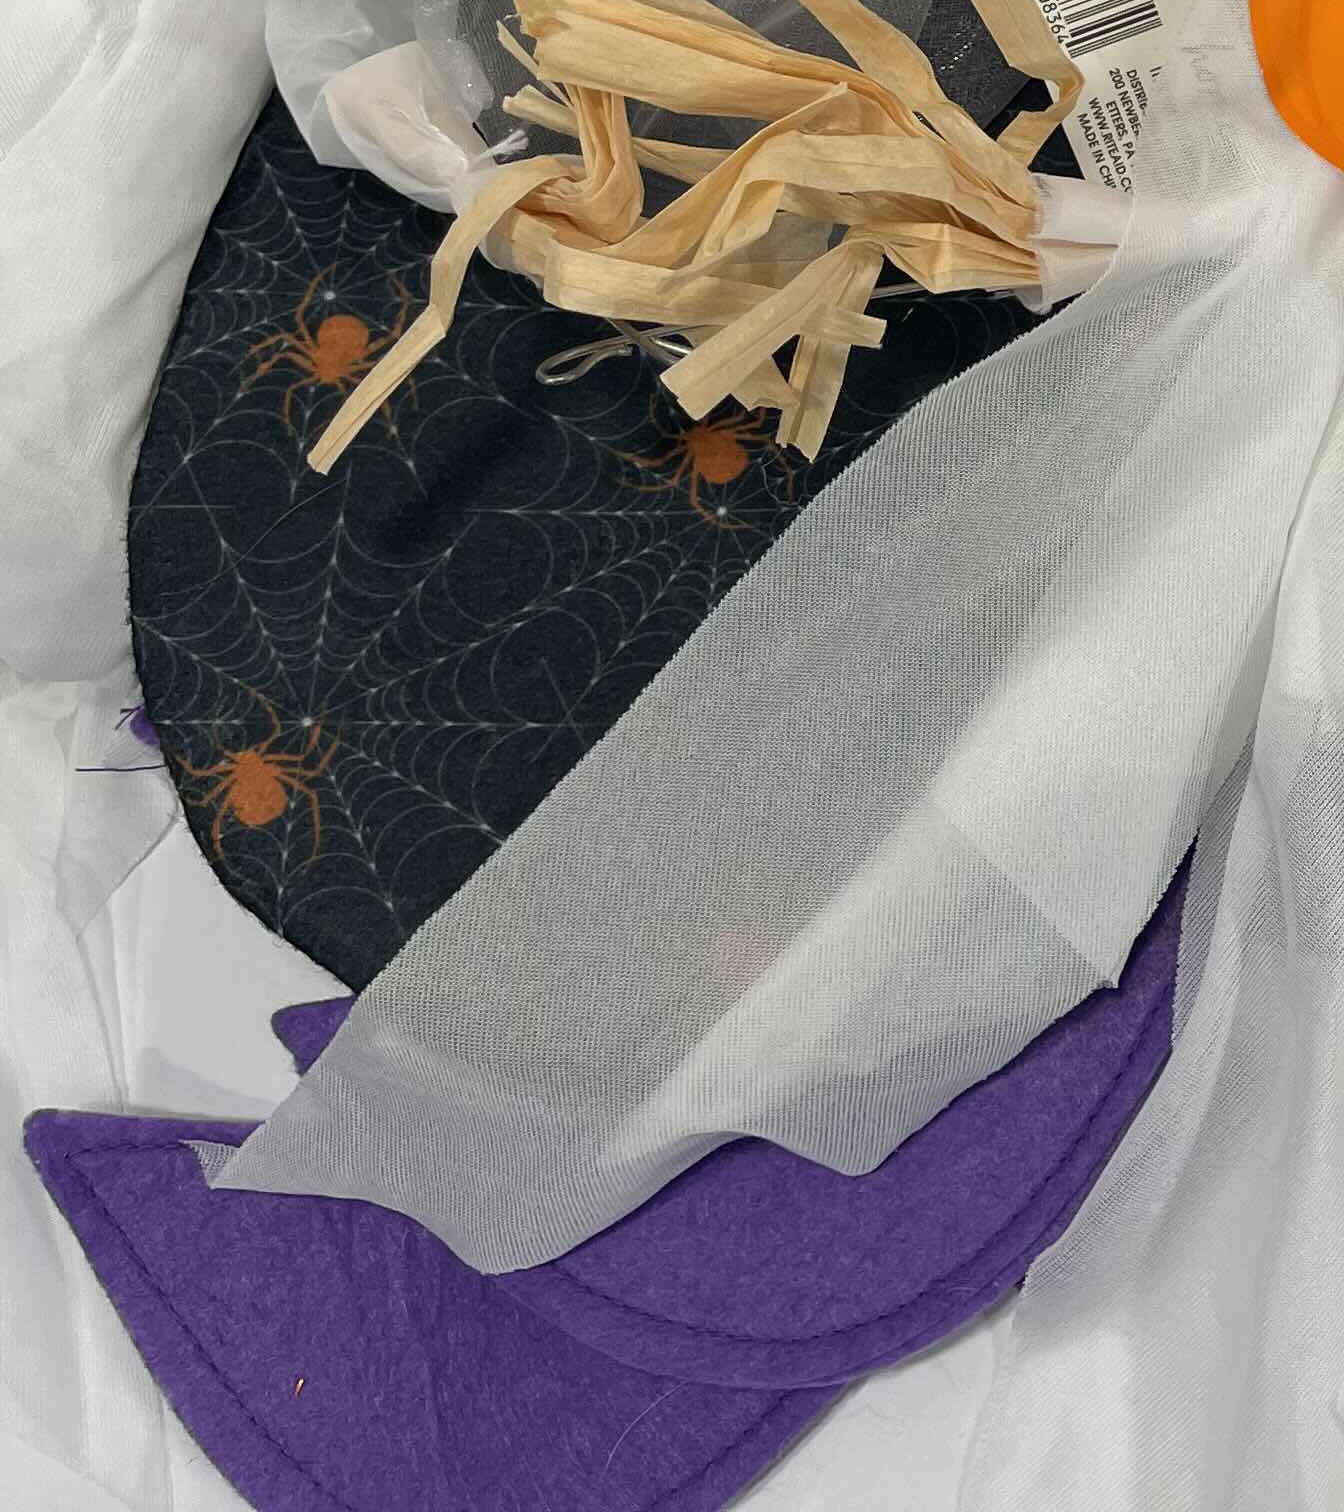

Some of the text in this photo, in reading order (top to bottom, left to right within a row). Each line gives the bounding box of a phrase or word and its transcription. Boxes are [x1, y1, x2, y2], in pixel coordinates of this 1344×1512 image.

[1109, 68, 1126, 90] 200
[1077, 113, 1100, 148] MADE
[1092, 149, 1106, 163] IN
[1122, 141, 1136, 159] PA
